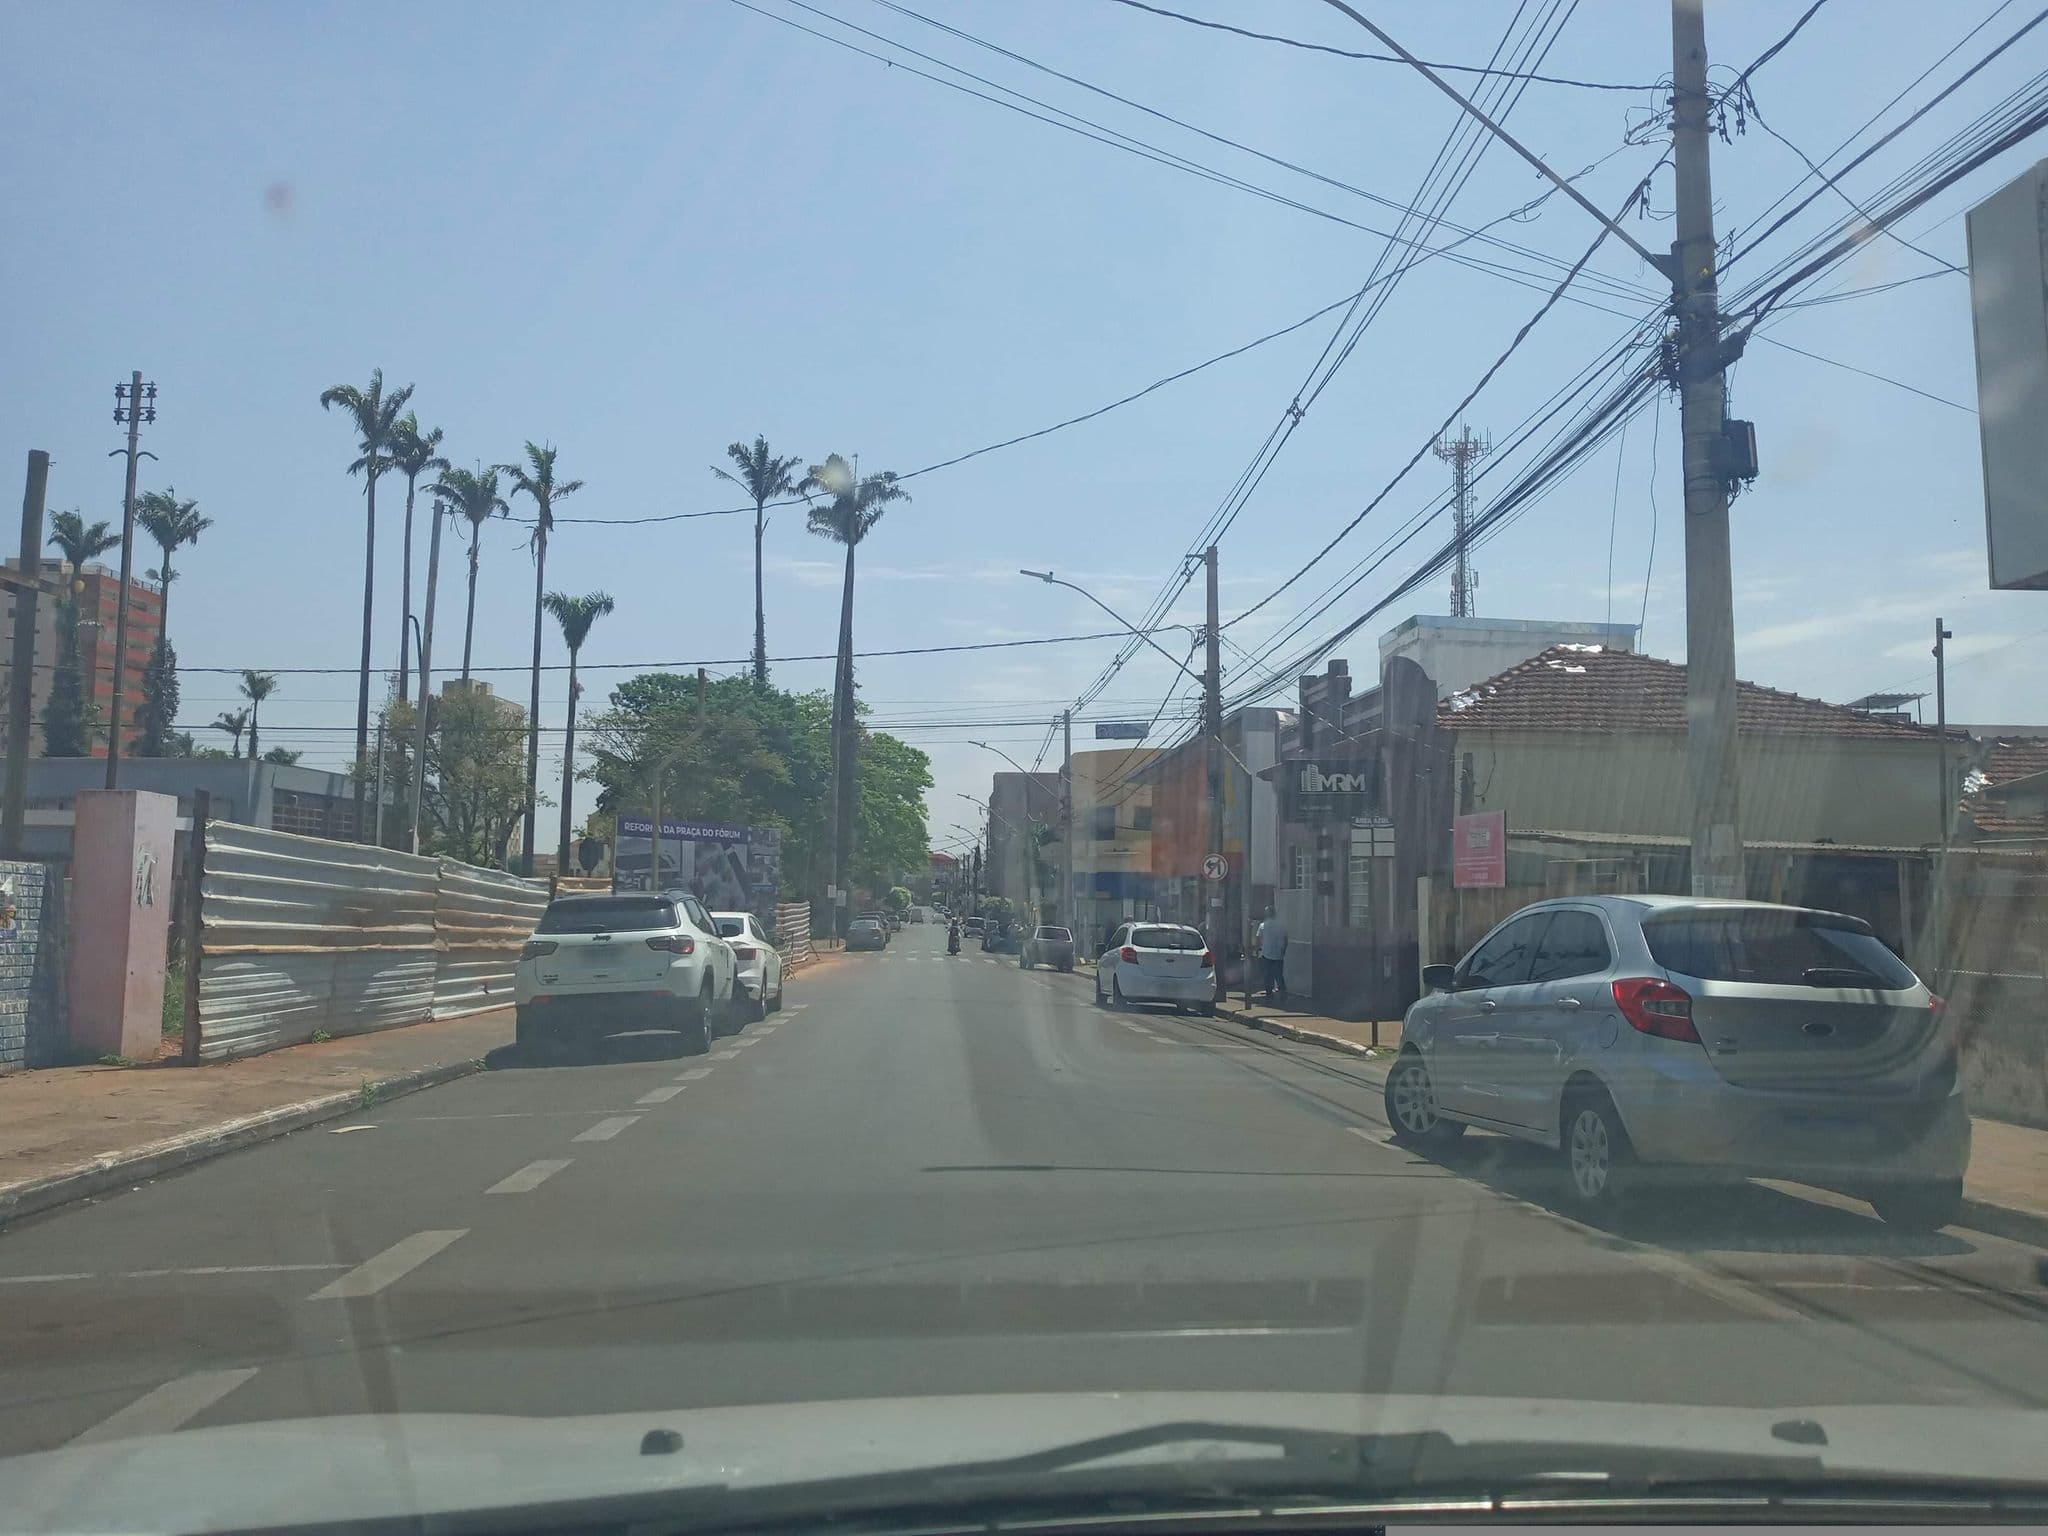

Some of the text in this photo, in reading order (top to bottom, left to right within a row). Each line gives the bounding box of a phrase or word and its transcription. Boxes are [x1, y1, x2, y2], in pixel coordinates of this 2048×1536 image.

[1320, 774, 1366, 792] MRM
[663, 826, 675, 835] DA
[676, 826, 702, 838] PRAÇA
[702, 829, 714, 837] DO
[715, 828, 741, 839] FÓRUM
